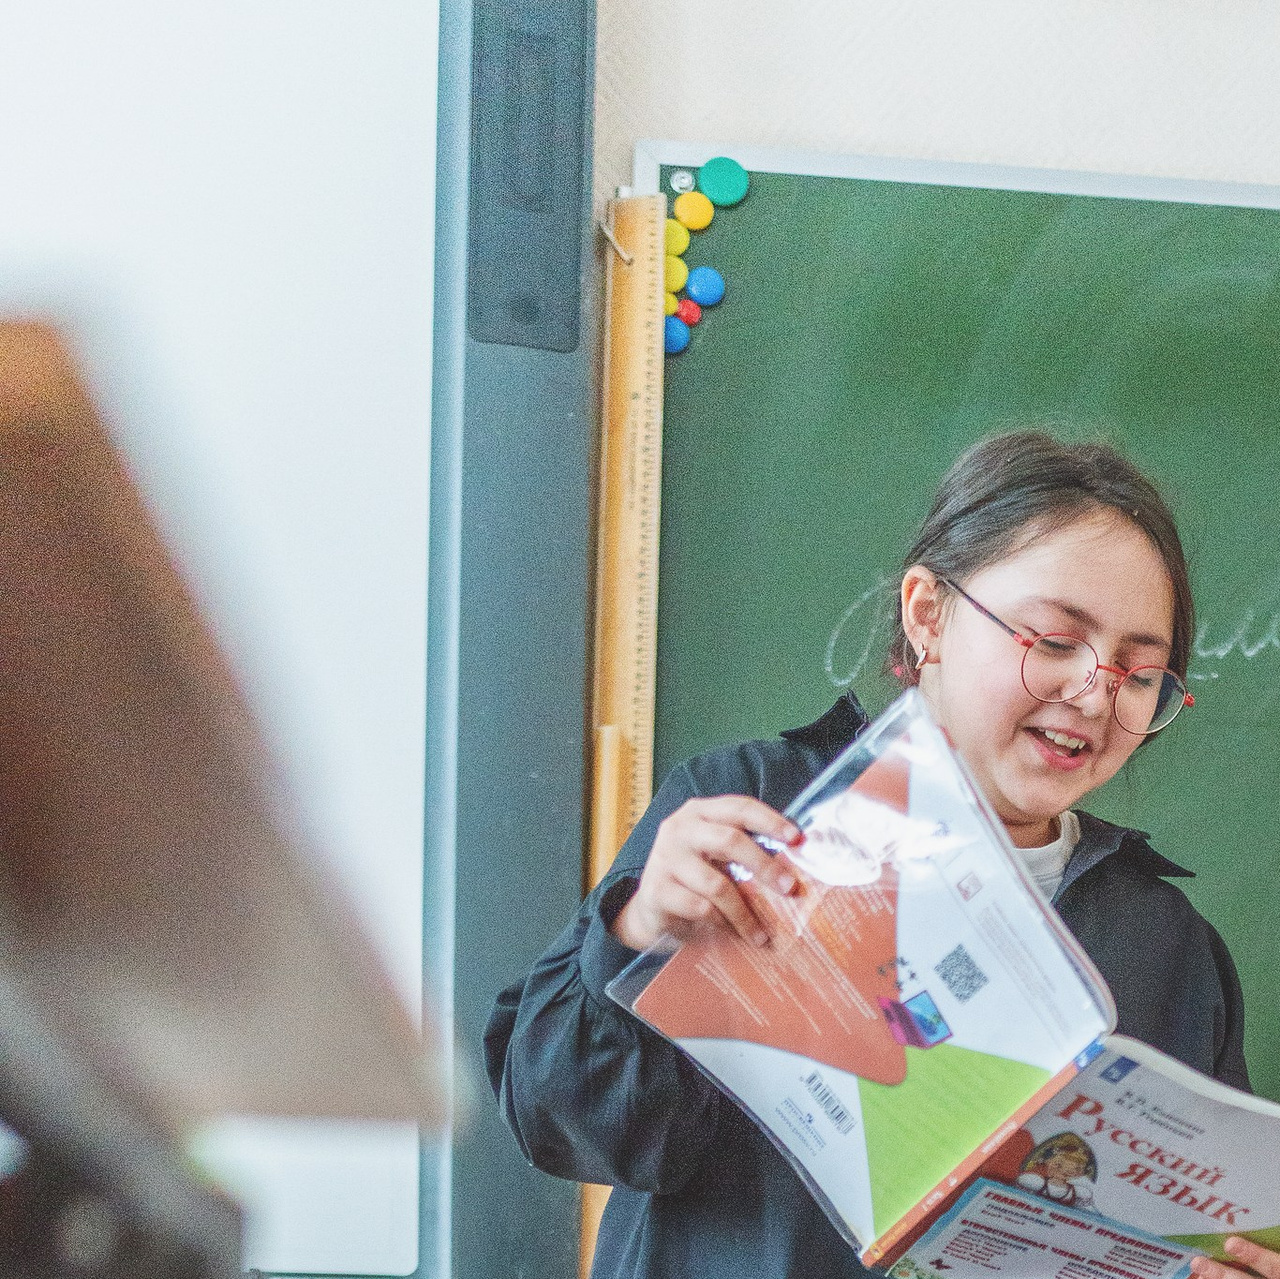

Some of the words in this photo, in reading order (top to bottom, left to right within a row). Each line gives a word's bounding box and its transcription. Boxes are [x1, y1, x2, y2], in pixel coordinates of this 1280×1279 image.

[1055, 1093, 1228, 1188] Русский
[1049, 1212, 1092, 1230] ЧЛЕНЫ
[1095, 1228, 1183, 1260] ПРЕДЛОЖЕНИЯ
